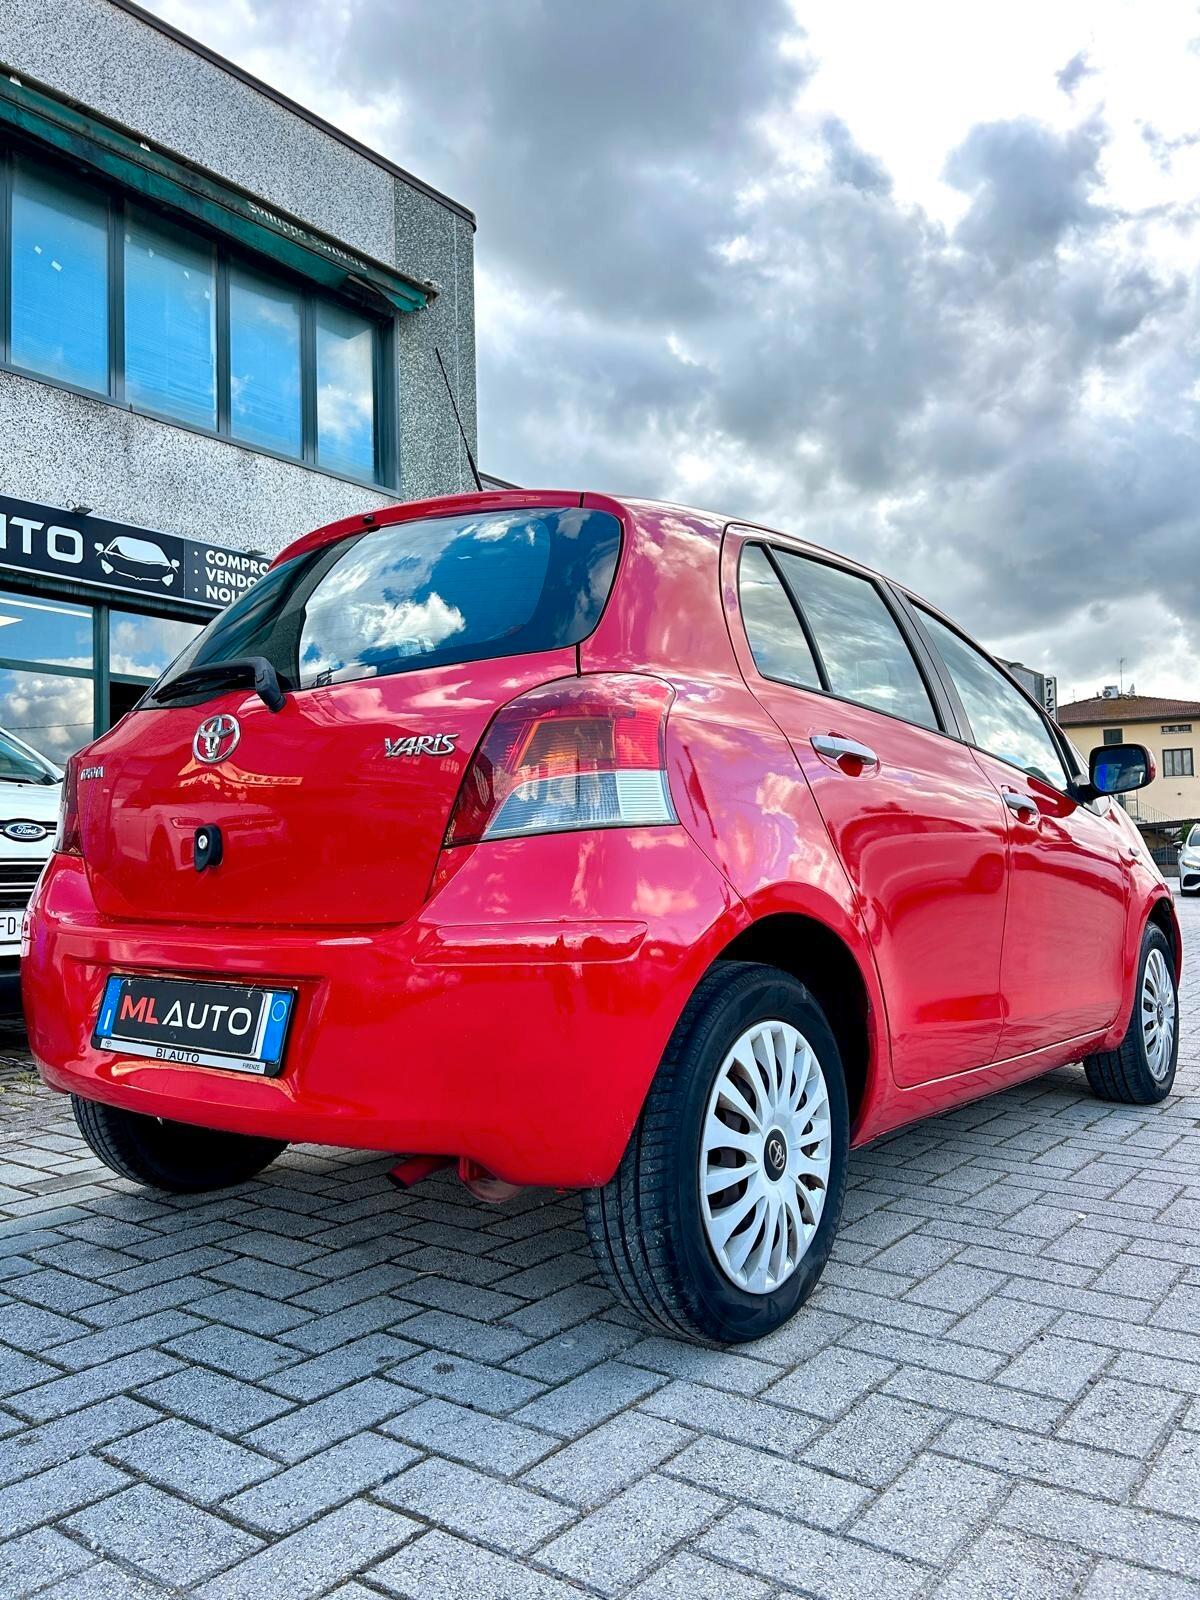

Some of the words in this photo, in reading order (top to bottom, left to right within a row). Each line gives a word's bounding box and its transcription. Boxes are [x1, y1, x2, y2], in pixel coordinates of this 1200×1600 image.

[0, 513, 84, 564] TO
[205, 549, 269, 576] COMPRO
[205, 566, 258, 589] VENDO
[1045, 680, 1054, 718] PIZZ
[16, 825, 38, 834] Ford
[119, 994, 159, 1025] ML
[161, 1000, 252, 1036] AUTO
[155, 1047, 166, 1059] BI
[168, 1049, 200, 1063] AUTO
[242, 1062, 260, 1071] FIRENZE
